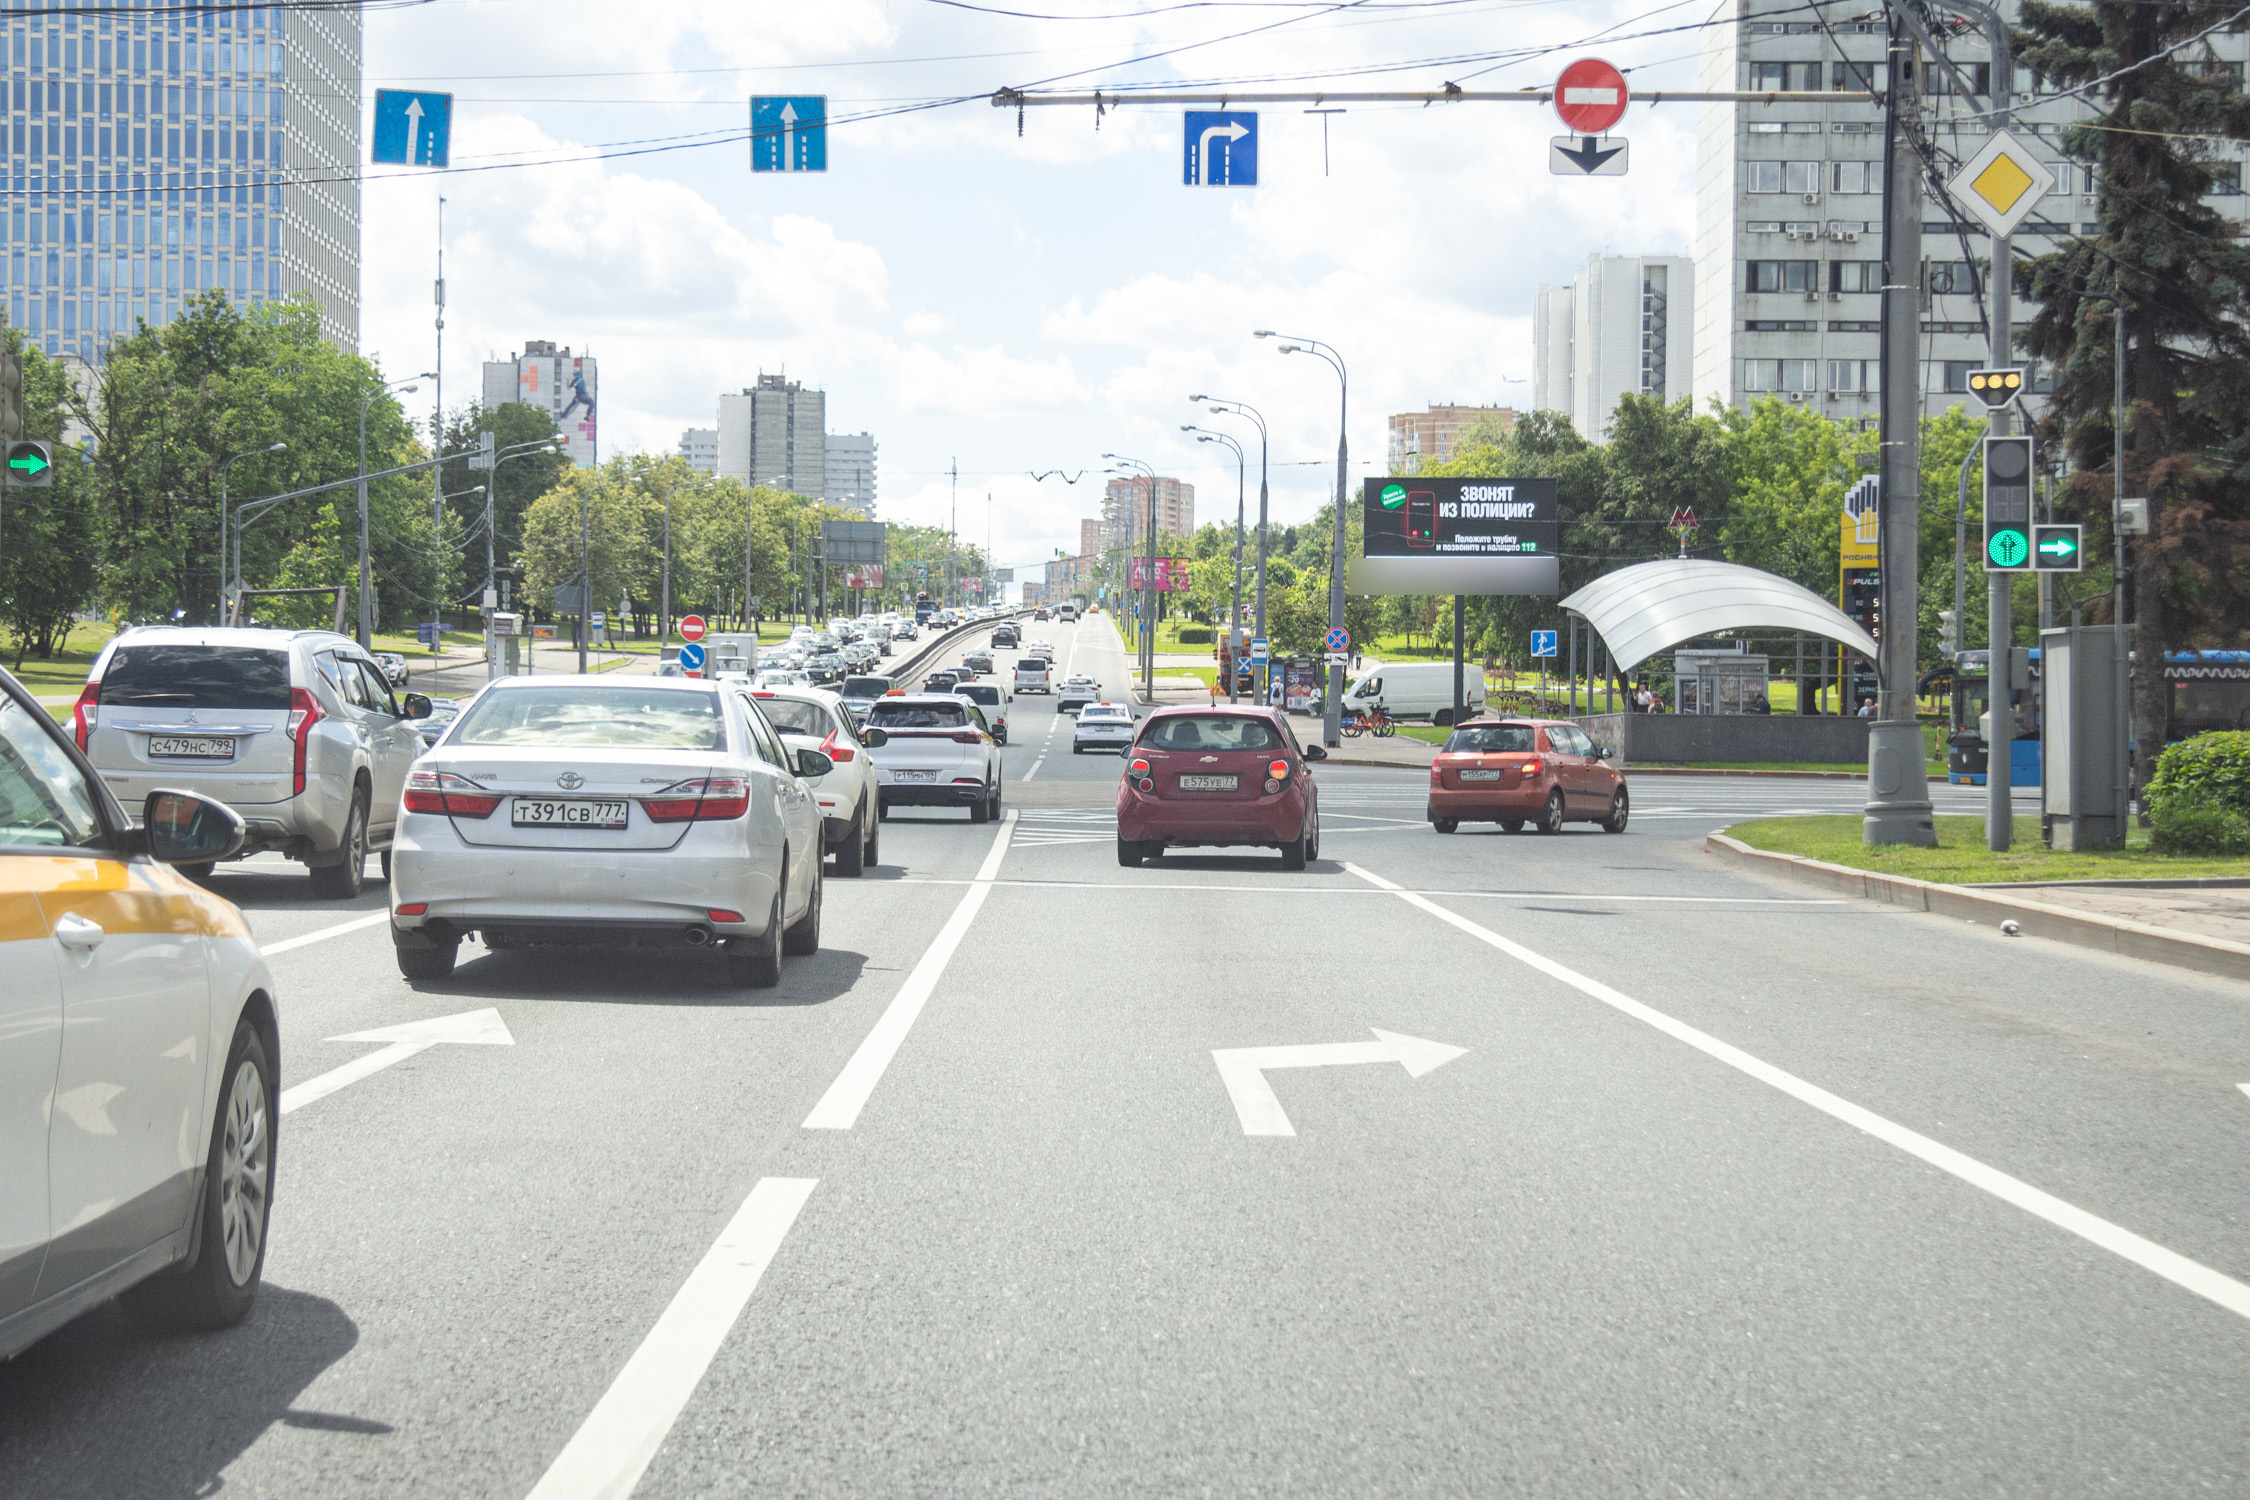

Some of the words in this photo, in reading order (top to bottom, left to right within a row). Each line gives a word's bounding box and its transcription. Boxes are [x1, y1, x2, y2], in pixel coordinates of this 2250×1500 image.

[1460, 486, 1515, 501] ЗВОНЯТ
[1439, 502, 1457, 518] ИЗ
[1461, 502, 1535, 520] ПОЛИЦИИ?
[1455, 534, 1492, 543] Положите
[1492, 534, 1517, 545] трубку
[1521, 543, 1536, 551] 112
[154, 739, 206, 753] С479НС
[210, 740, 230, 750] 799
[1184, 777, 1222, 787] Е575УЕ
[1225, 777, 1234, 785] 77
[519, 803, 590, 821] Т391СВ
[594, 804, 622, 817] 777
